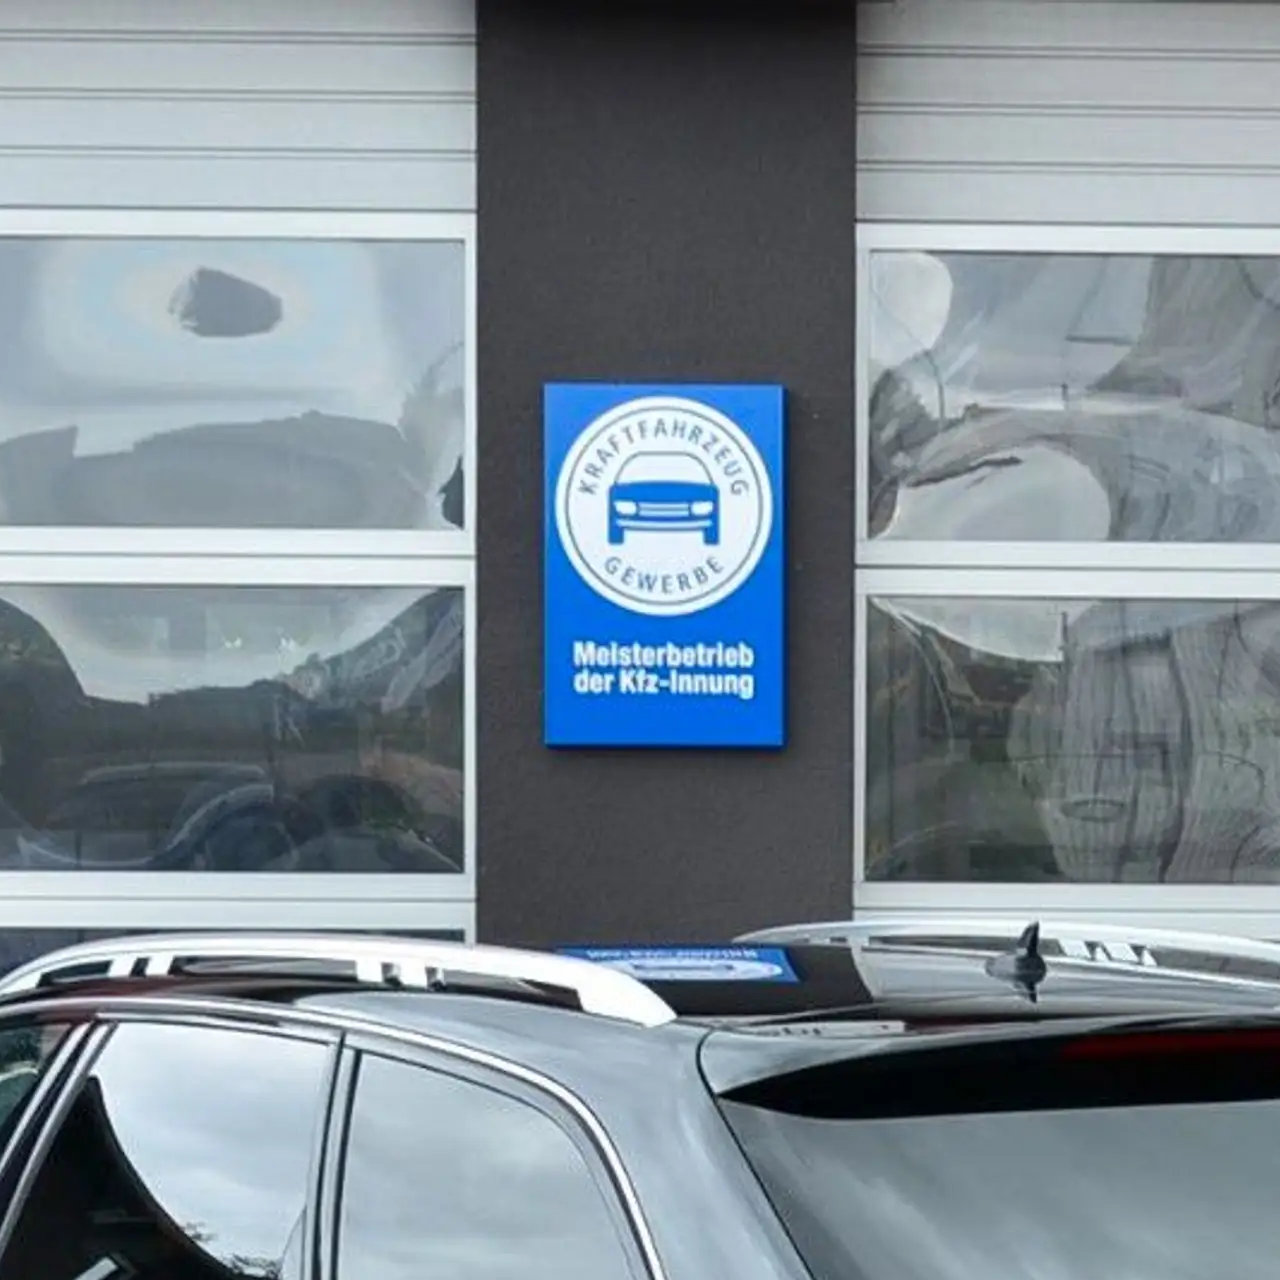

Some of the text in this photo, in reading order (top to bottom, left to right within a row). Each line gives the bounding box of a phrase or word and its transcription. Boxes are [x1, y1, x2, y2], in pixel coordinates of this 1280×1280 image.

[577, 417, 750, 496] KRAFTFAHRZEUG
[604, 556, 725, 594] GEWERBE
[572, 641, 755, 668] Meisterbetrieb
[573, 669, 755, 700] der Kfz-Innung
